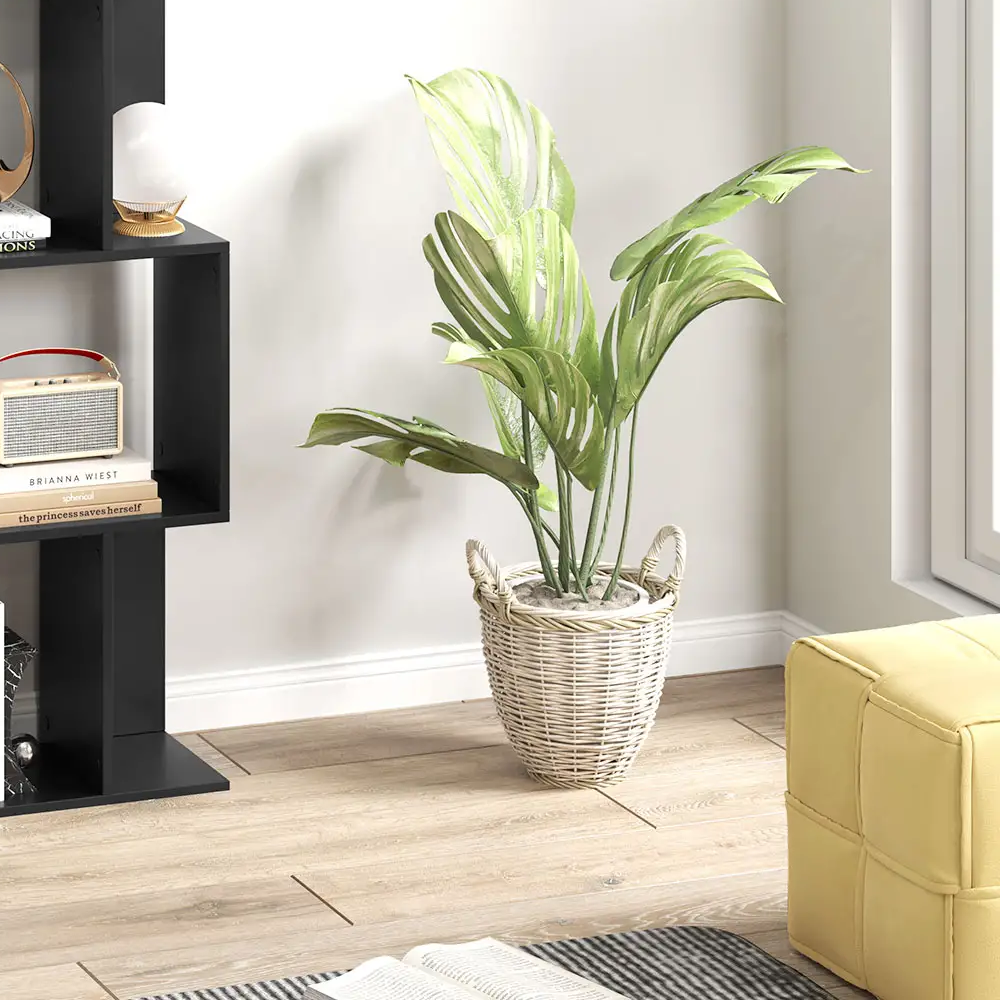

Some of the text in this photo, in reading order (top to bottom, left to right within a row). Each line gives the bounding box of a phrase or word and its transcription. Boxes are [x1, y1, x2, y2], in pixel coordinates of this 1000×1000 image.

[29, 470, 119, 486] BRIANNA WIEST
[35, 511, 78, 524] princess
[79, 509, 106, 518] saves
[106, 503, 142, 515] herself
